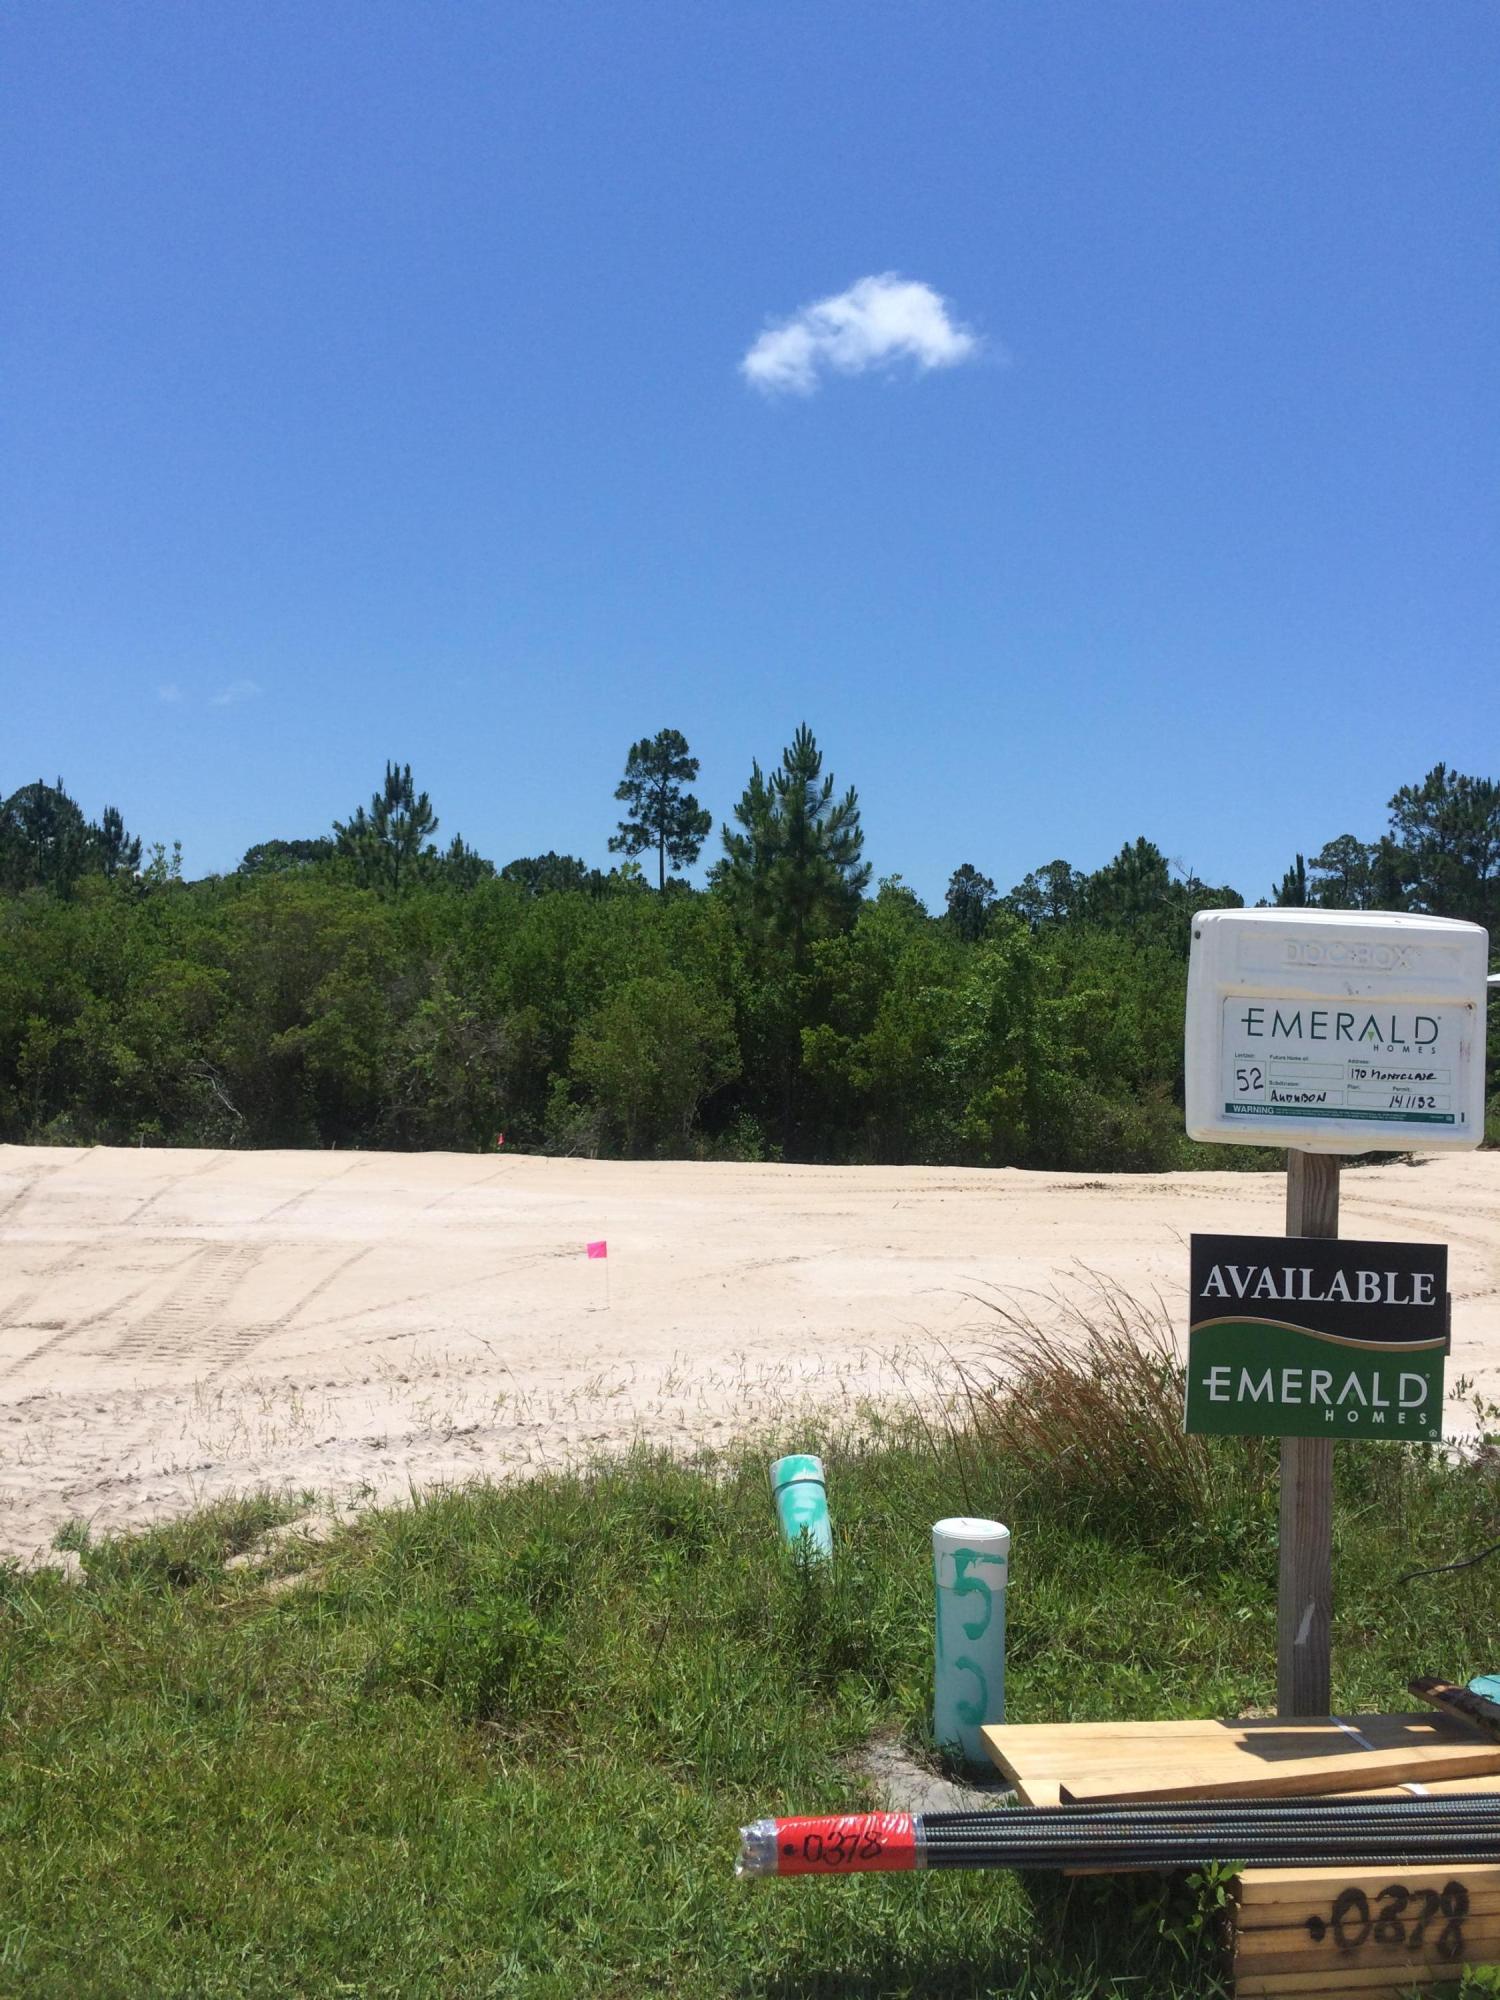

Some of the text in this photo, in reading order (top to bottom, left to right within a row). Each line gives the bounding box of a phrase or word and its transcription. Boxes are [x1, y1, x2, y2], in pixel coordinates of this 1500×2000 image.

[1241, 1007, 1440, 1045] EMERALD
[1373, 1044, 1436, 1054] HOMES
[1236, 1067, 1264, 1091] 52
[1351, 1068, 1367, 1080] 170
[1233, 1105, 1274, 1114] WARNING
[1200, 1264, 1436, 1306] AVAILABLE
[1202, 1366, 1428, 1408] EMERALD
[1325, 1409, 1427, 1425] HOMES
